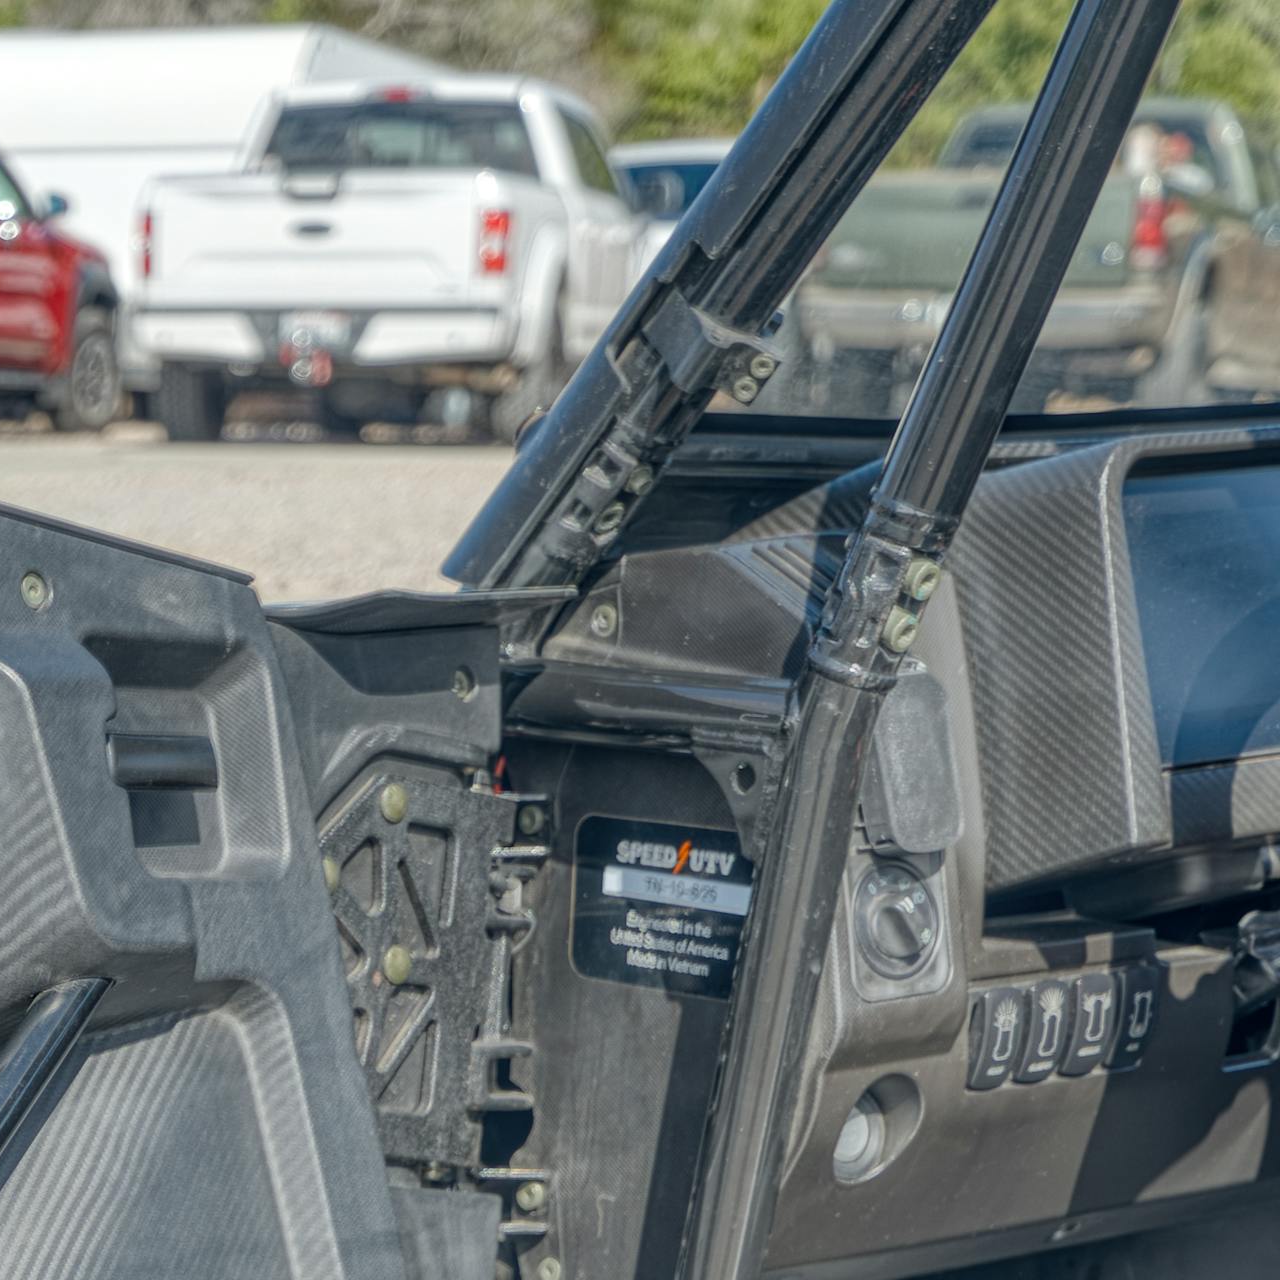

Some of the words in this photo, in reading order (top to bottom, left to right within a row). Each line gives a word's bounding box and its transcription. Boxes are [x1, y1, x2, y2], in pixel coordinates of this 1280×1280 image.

[616, 839, 677, 869] SPEED
[689, 848, 735, 876] UTV
[610, 926, 643, 948] United
[643, 931, 675, 953] States
[676, 938, 688, 954] of
[686, 940, 729, 961] America
[683, 919, 695, 936] in
[695, 921, 712, 938] the
[626, 948, 656, 969] Made
[657, 957, 668, 971] in
[668, 957, 710, 977] Vietnam
